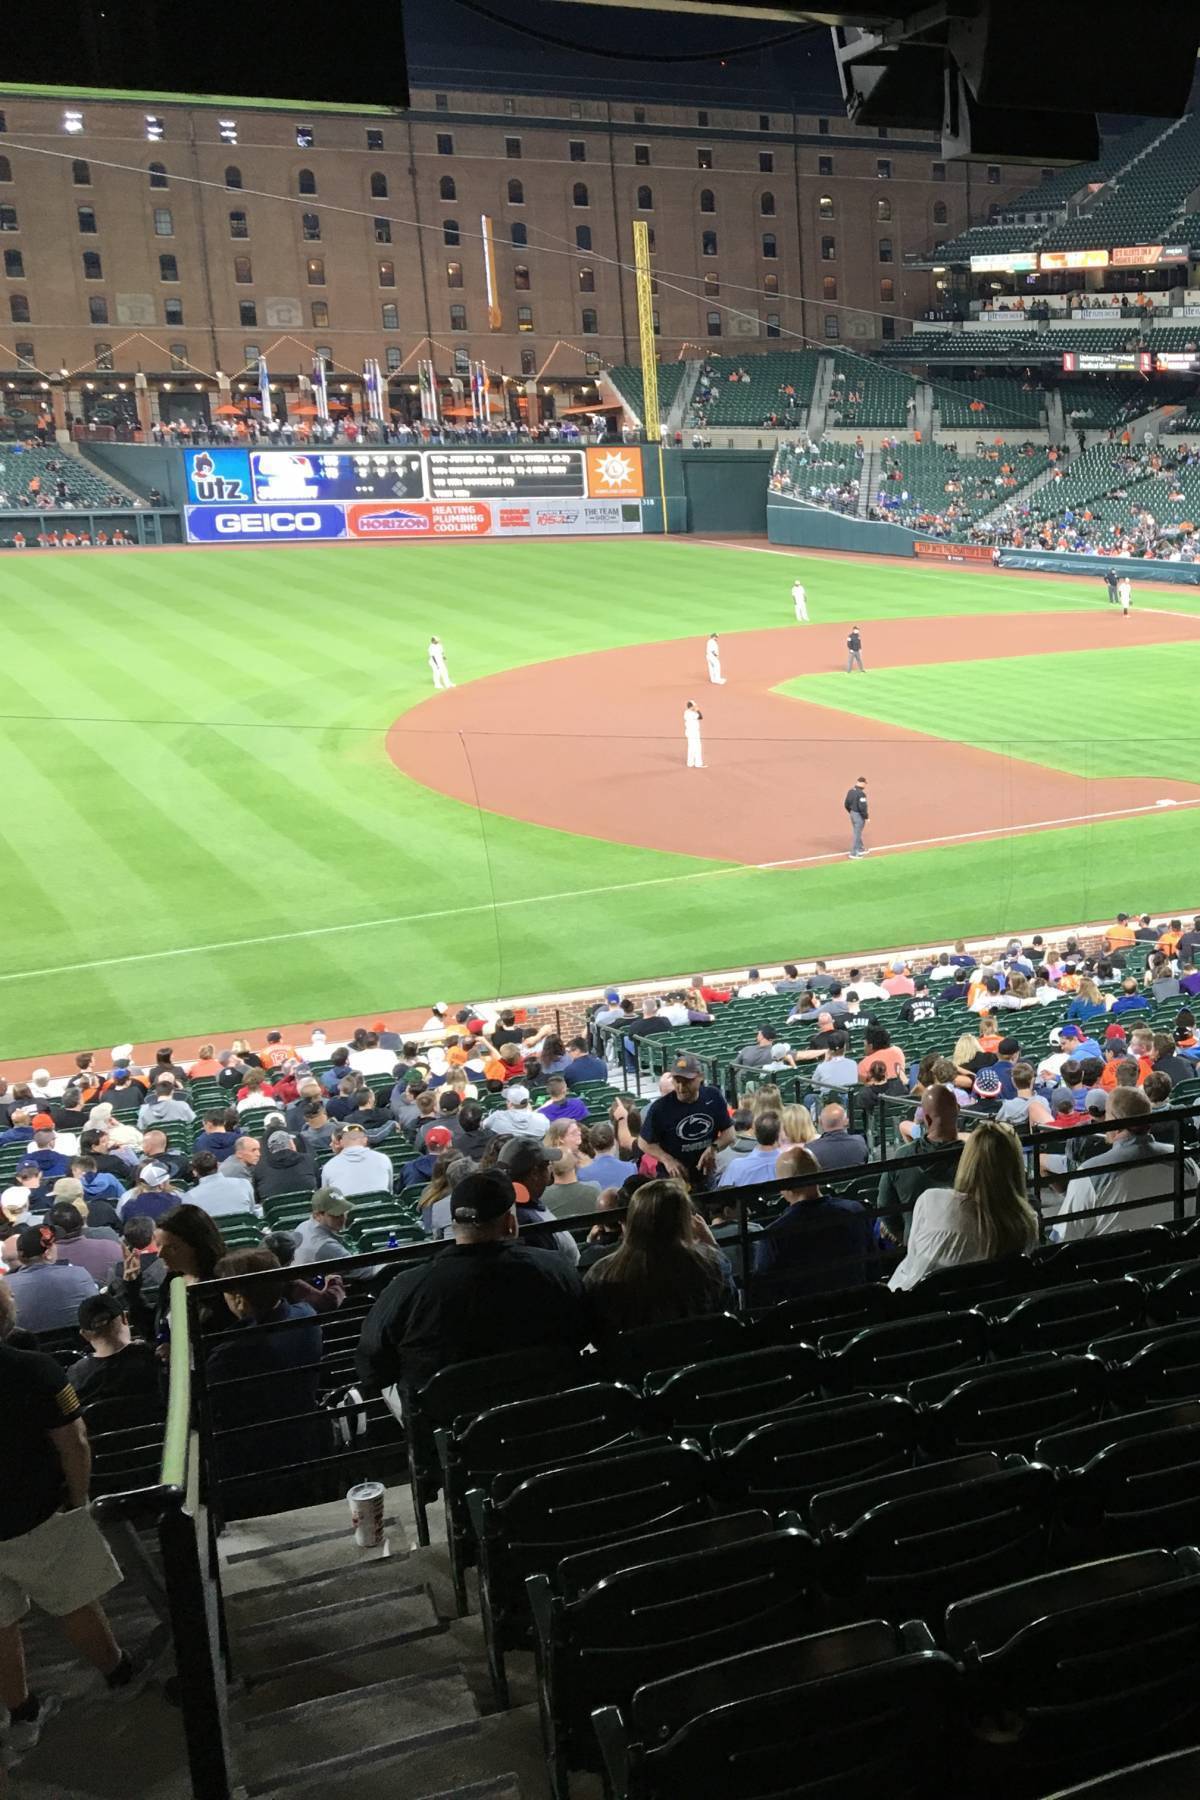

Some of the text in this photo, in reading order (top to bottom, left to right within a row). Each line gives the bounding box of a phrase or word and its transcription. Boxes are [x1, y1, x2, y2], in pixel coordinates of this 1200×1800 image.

[431, 505, 476, 515] HEATING
[584, 507, 620, 517] THE TEAM
[215, 512, 322, 533] GEICO
[360, 517, 428, 530] HORIZON
[432, 514, 484, 524] PLUMBING
[433, 522, 479, 533] COOLING
[913, 1007, 936, 1022] 23
